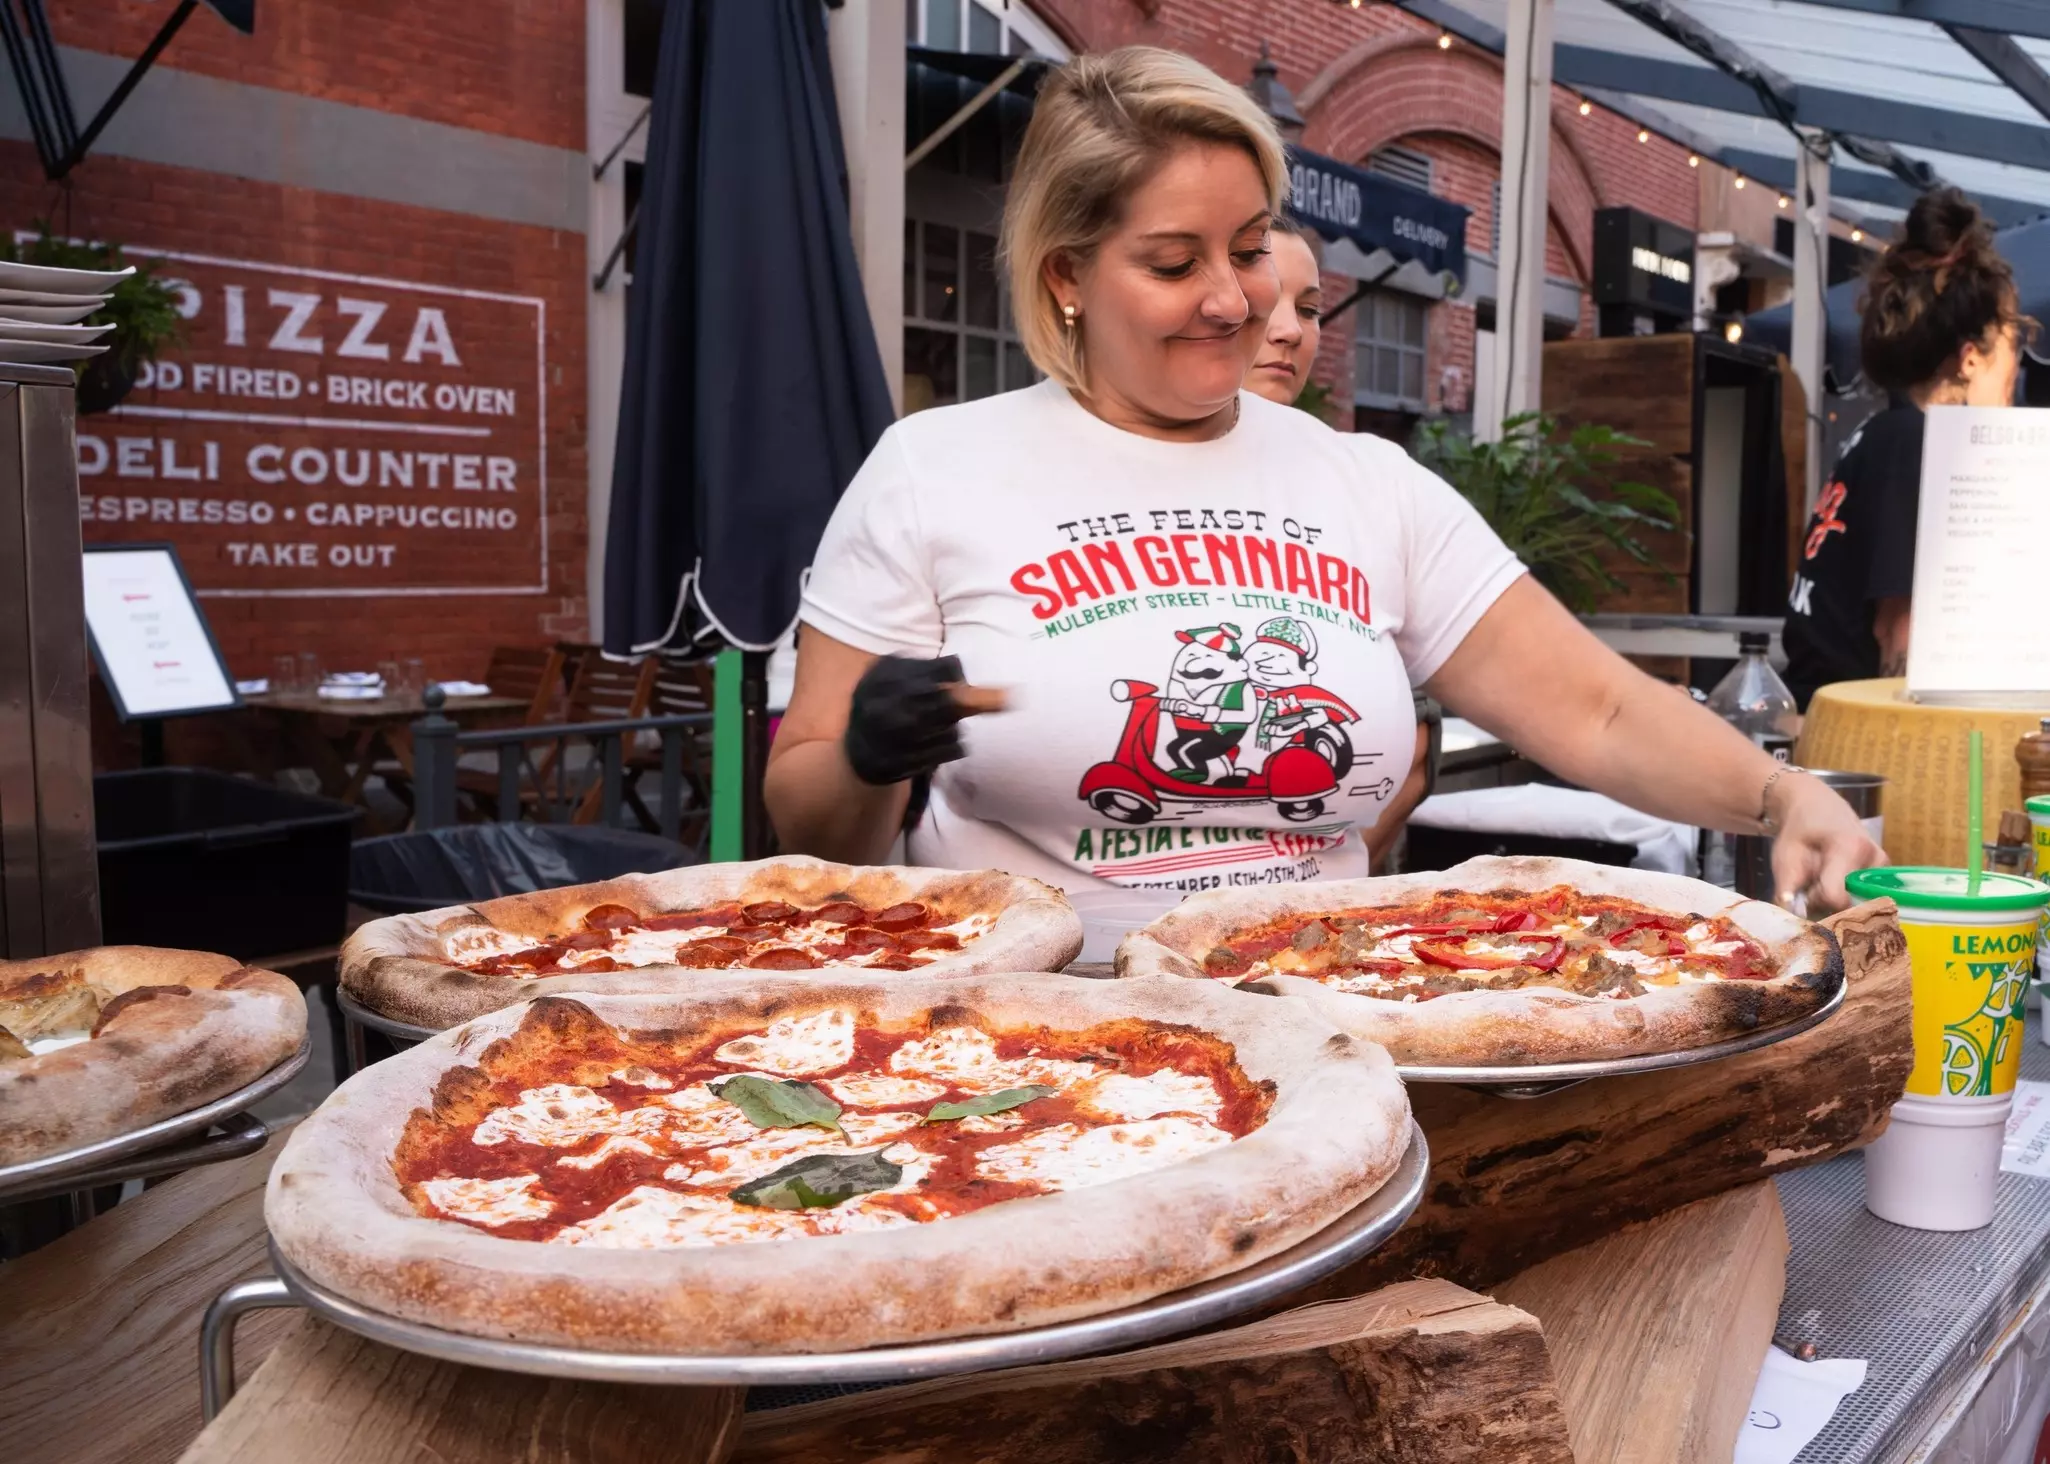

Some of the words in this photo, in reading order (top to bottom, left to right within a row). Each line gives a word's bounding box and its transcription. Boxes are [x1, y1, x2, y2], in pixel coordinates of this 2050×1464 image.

[192, 363, 301, 400] FIRED
[327, 374, 429, 410] BRICK
[434, 384, 516, 416] OVEN
[76, 435, 220, 481] DELI
[246, 444, 518, 492] COUNTER
[79, 494, 274, 524] ESPRESSO
[306, 502, 518, 529] CAPPUCCINO
[1056, 513, 1135, 542] THE
[1149, 509, 1266, 531] FEAST
[1283, 518, 1322, 545] OF
[226, 543, 318, 567] TAKE
[328, 544, 396, 567] OUT
[1009, 541, 1138, 620] SAN
[1133, 534, 1371, 626] GENNARO
[1045, 597, 1139, 638] MULBERRY
[1145, 592, 1210, 609] STREET
[1232, 592, 1292, 612] LITTLE
[1075, 828, 1093, 861] A
